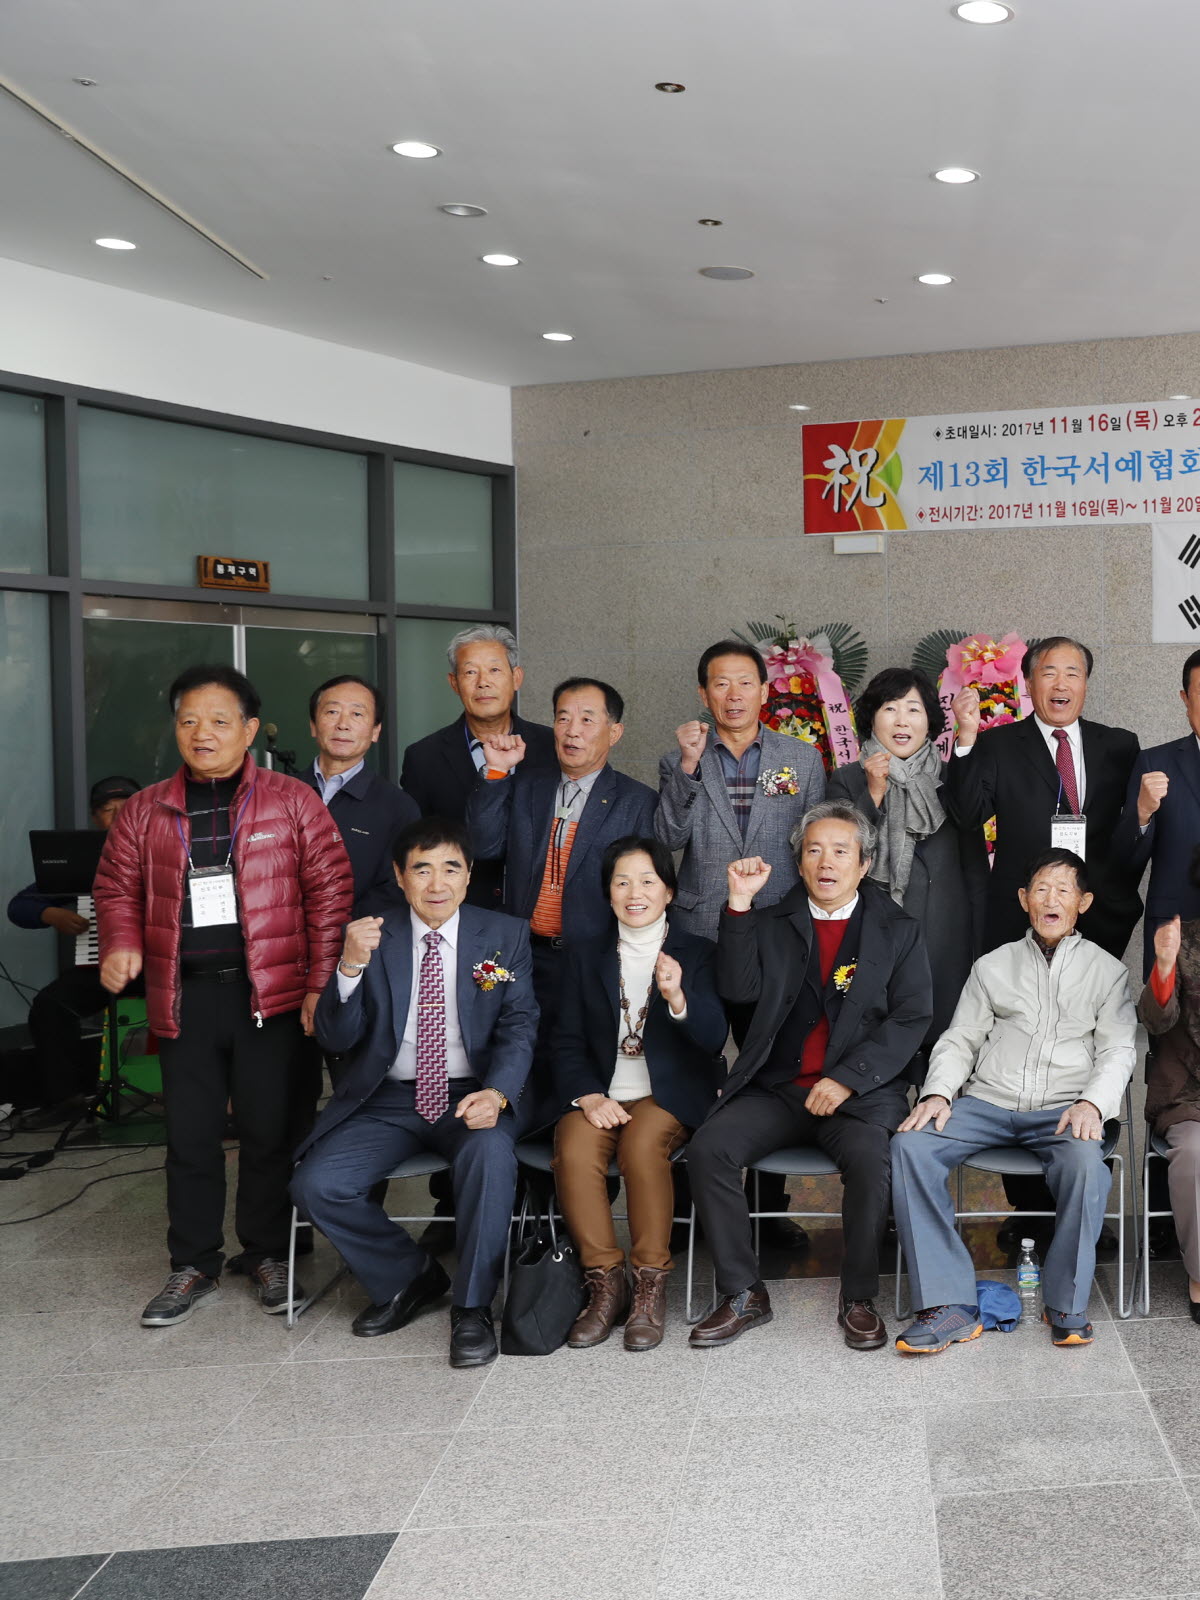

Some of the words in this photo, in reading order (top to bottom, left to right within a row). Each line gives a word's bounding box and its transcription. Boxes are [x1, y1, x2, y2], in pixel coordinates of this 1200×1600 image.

[945, 424, 997, 440] 초대일시:
[1002, 421, 1044, 437] 2017년
[1049, 416, 1083, 434] 11월
[1088, 413, 1121, 432] 16일
[1126, 409, 1158, 432] (목)
[1163, 413, 1188, 428] 오후
[822, 444, 887, 514] 祝
[918, 456, 1008, 492] 제13회
[928, 505, 983, 522] 전시기간:
[988, 503, 1033, 520] 2017년
[1038, 500, 1067, 518] 11월
[1143, 496, 1172, 514] 11월
[216, 564, 257, 577] 통제구역
[829, 703, 847, 713] 祝
